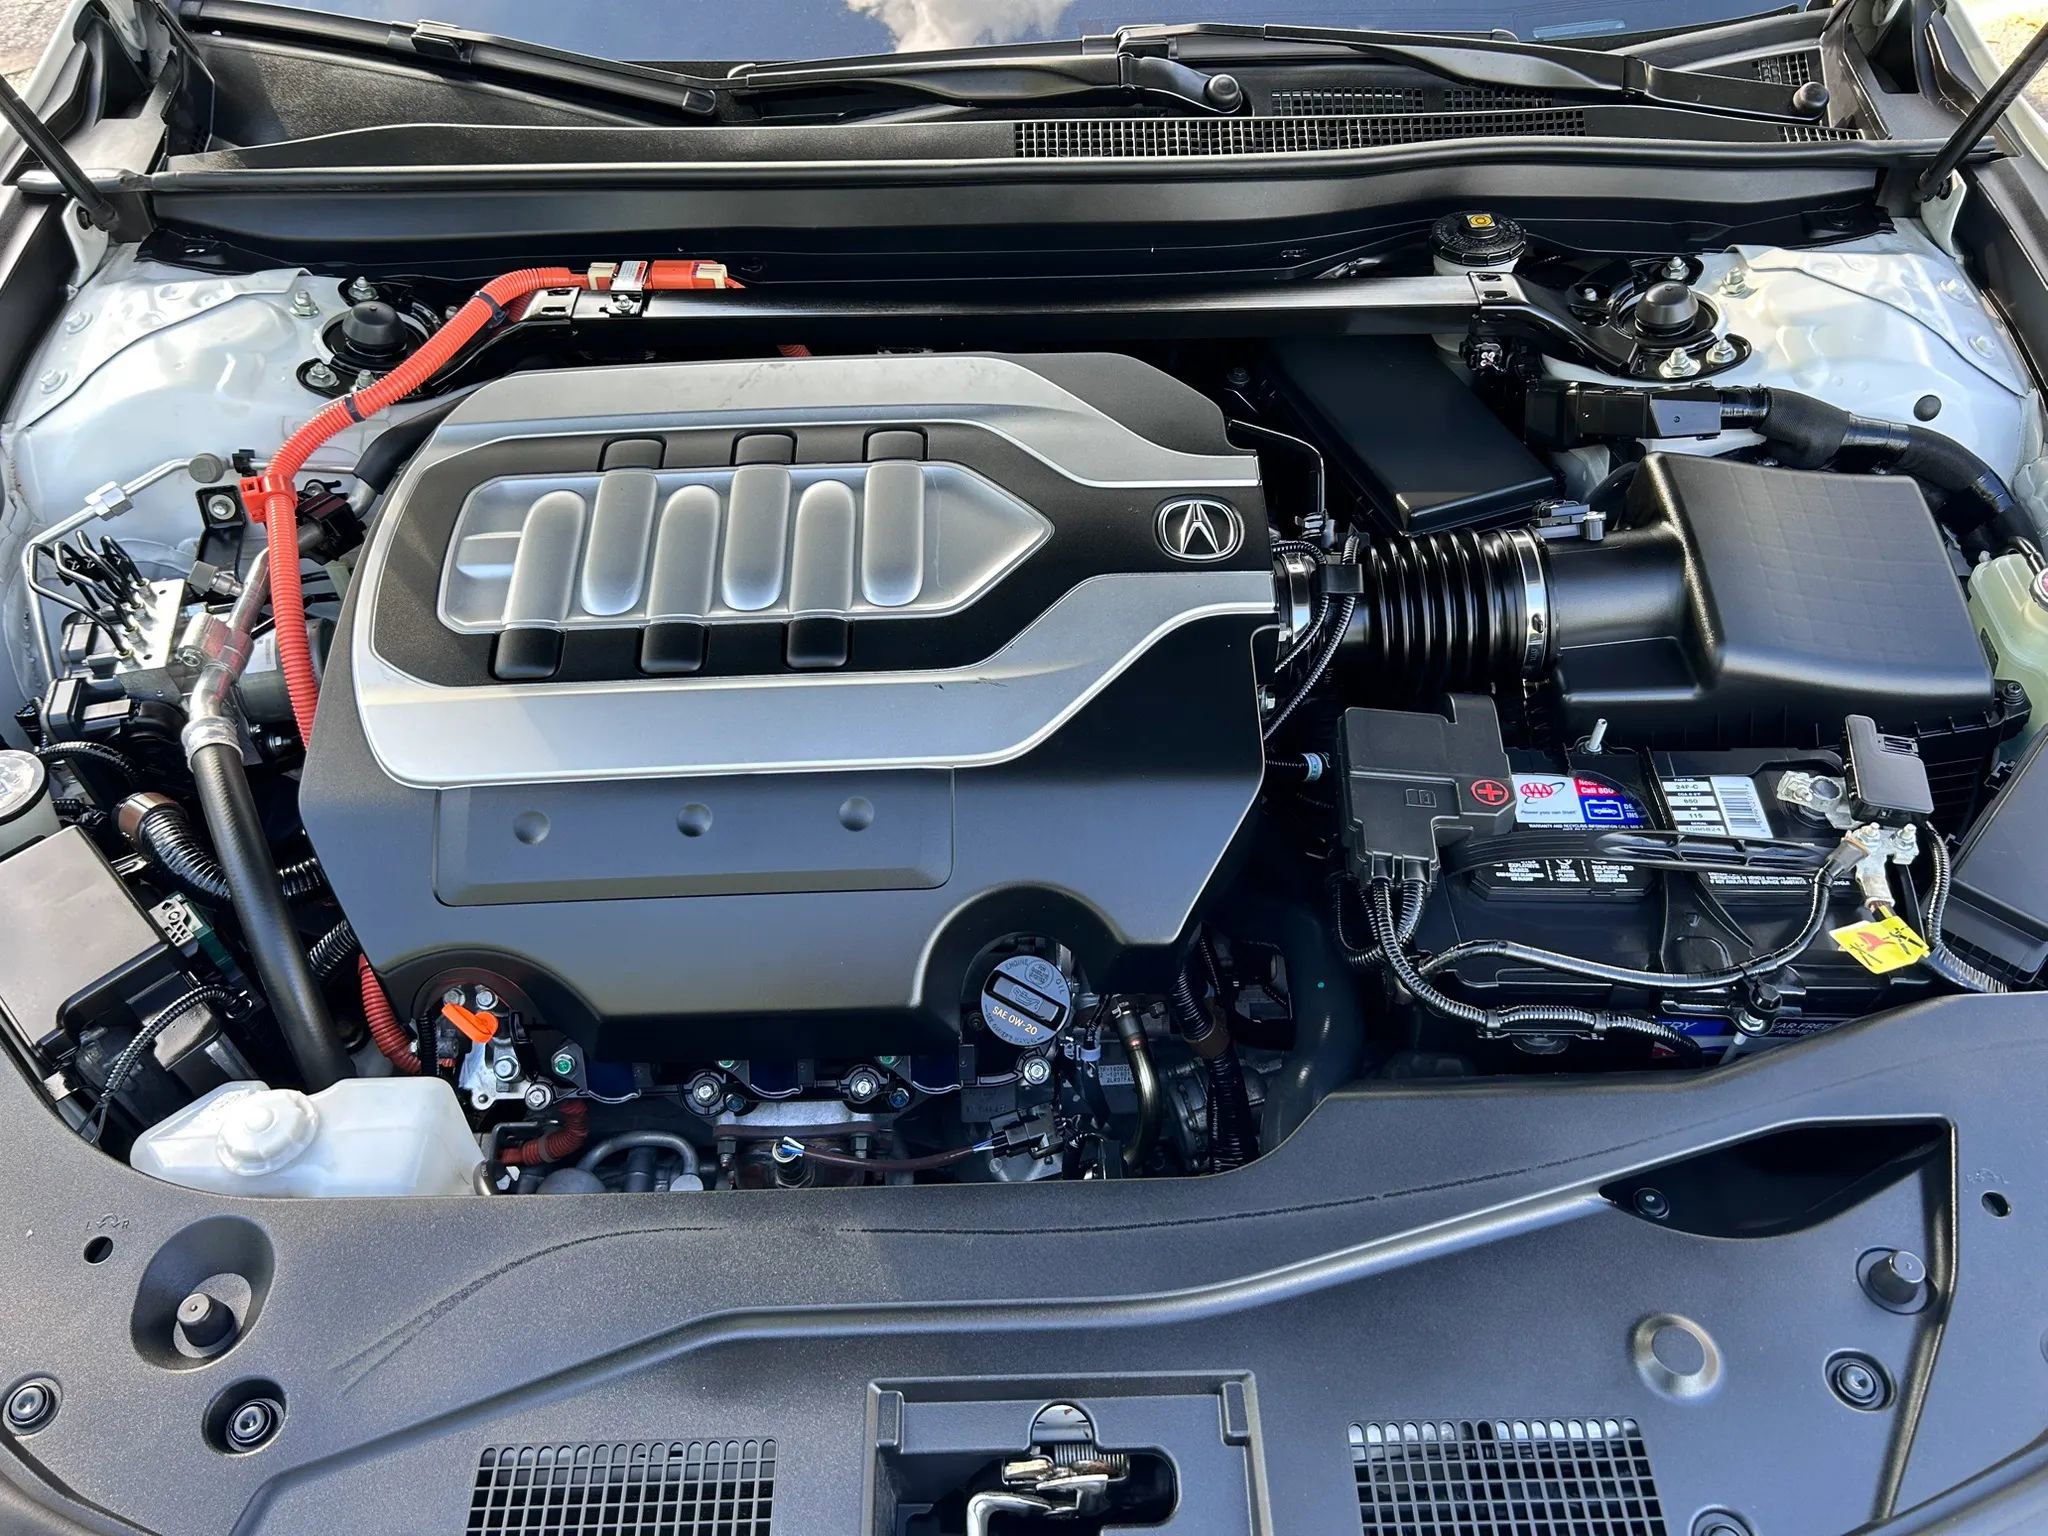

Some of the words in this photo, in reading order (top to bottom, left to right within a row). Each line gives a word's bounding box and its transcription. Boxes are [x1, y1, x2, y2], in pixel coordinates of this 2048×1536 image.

[1521, 783, 1553, 798] AAA
[1004, 959, 1030, 971] ENGINE
[1055, 978, 1067, 995] OIL
[992, 1006, 1009, 1020] SAE
[1008, 1014, 1038, 1036] 0W-20
